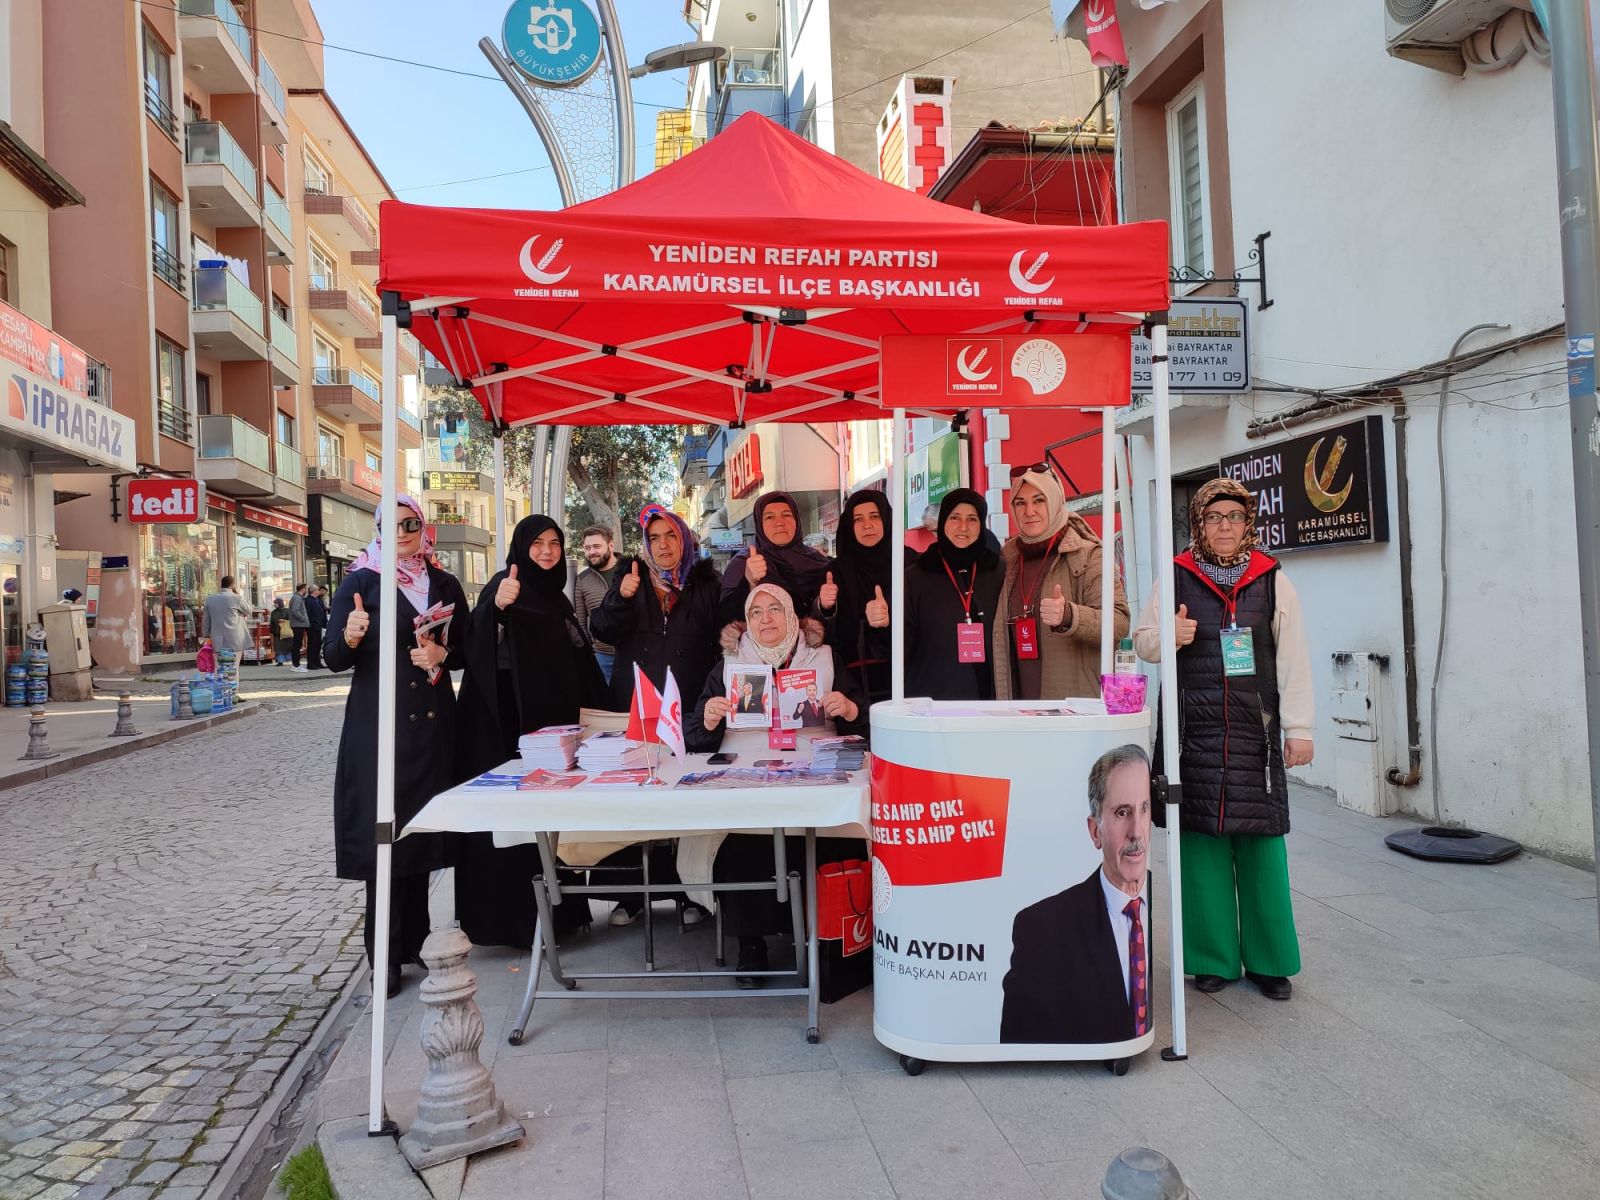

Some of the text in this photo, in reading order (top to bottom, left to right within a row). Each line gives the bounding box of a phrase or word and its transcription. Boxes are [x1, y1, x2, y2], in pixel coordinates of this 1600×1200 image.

[516, 49, 590, 77] BÜYÜKŞEHİR
[649, 241, 938, 268] YENİDEN REFAH PARTİSİ
[513, 286, 579, 298] YENİDEN REFAH
[603, 273, 980, 300] KARAMÜRSEL İLÇE BAŞKANLIĞI
[1004, 296, 1063, 306] YENİDEN REFAH
[1177, 343, 1233, 352] BAYRAKTAR
[1173, 357, 1228, 366] BAYRAKTAR
[952, 382, 977, 391] YENİDEN
[1169, 371, 1196, 381] 177
[1204, 371, 1217, 381] 11
[1223, 371, 1242, 382] 09
[1224, 453, 1282, 483] YENİDEN
[911, 472, 925, 495] HDI
[132, 487, 195, 516] tedi
[1256, 517, 1286, 547] TİSİ
[1298, 511, 1367, 531] KARAMÜRSEL
[1317, 523, 1368, 542] BAŞKANLIĞI
[930, 799, 964, 821] ÇIK!
[961, 819, 995, 842] ÇIK!
[906, 939, 985, 962] AYDIN
[898, 964, 945, 980] BAŞKAN
[949, 970, 987, 983] ADAYI
